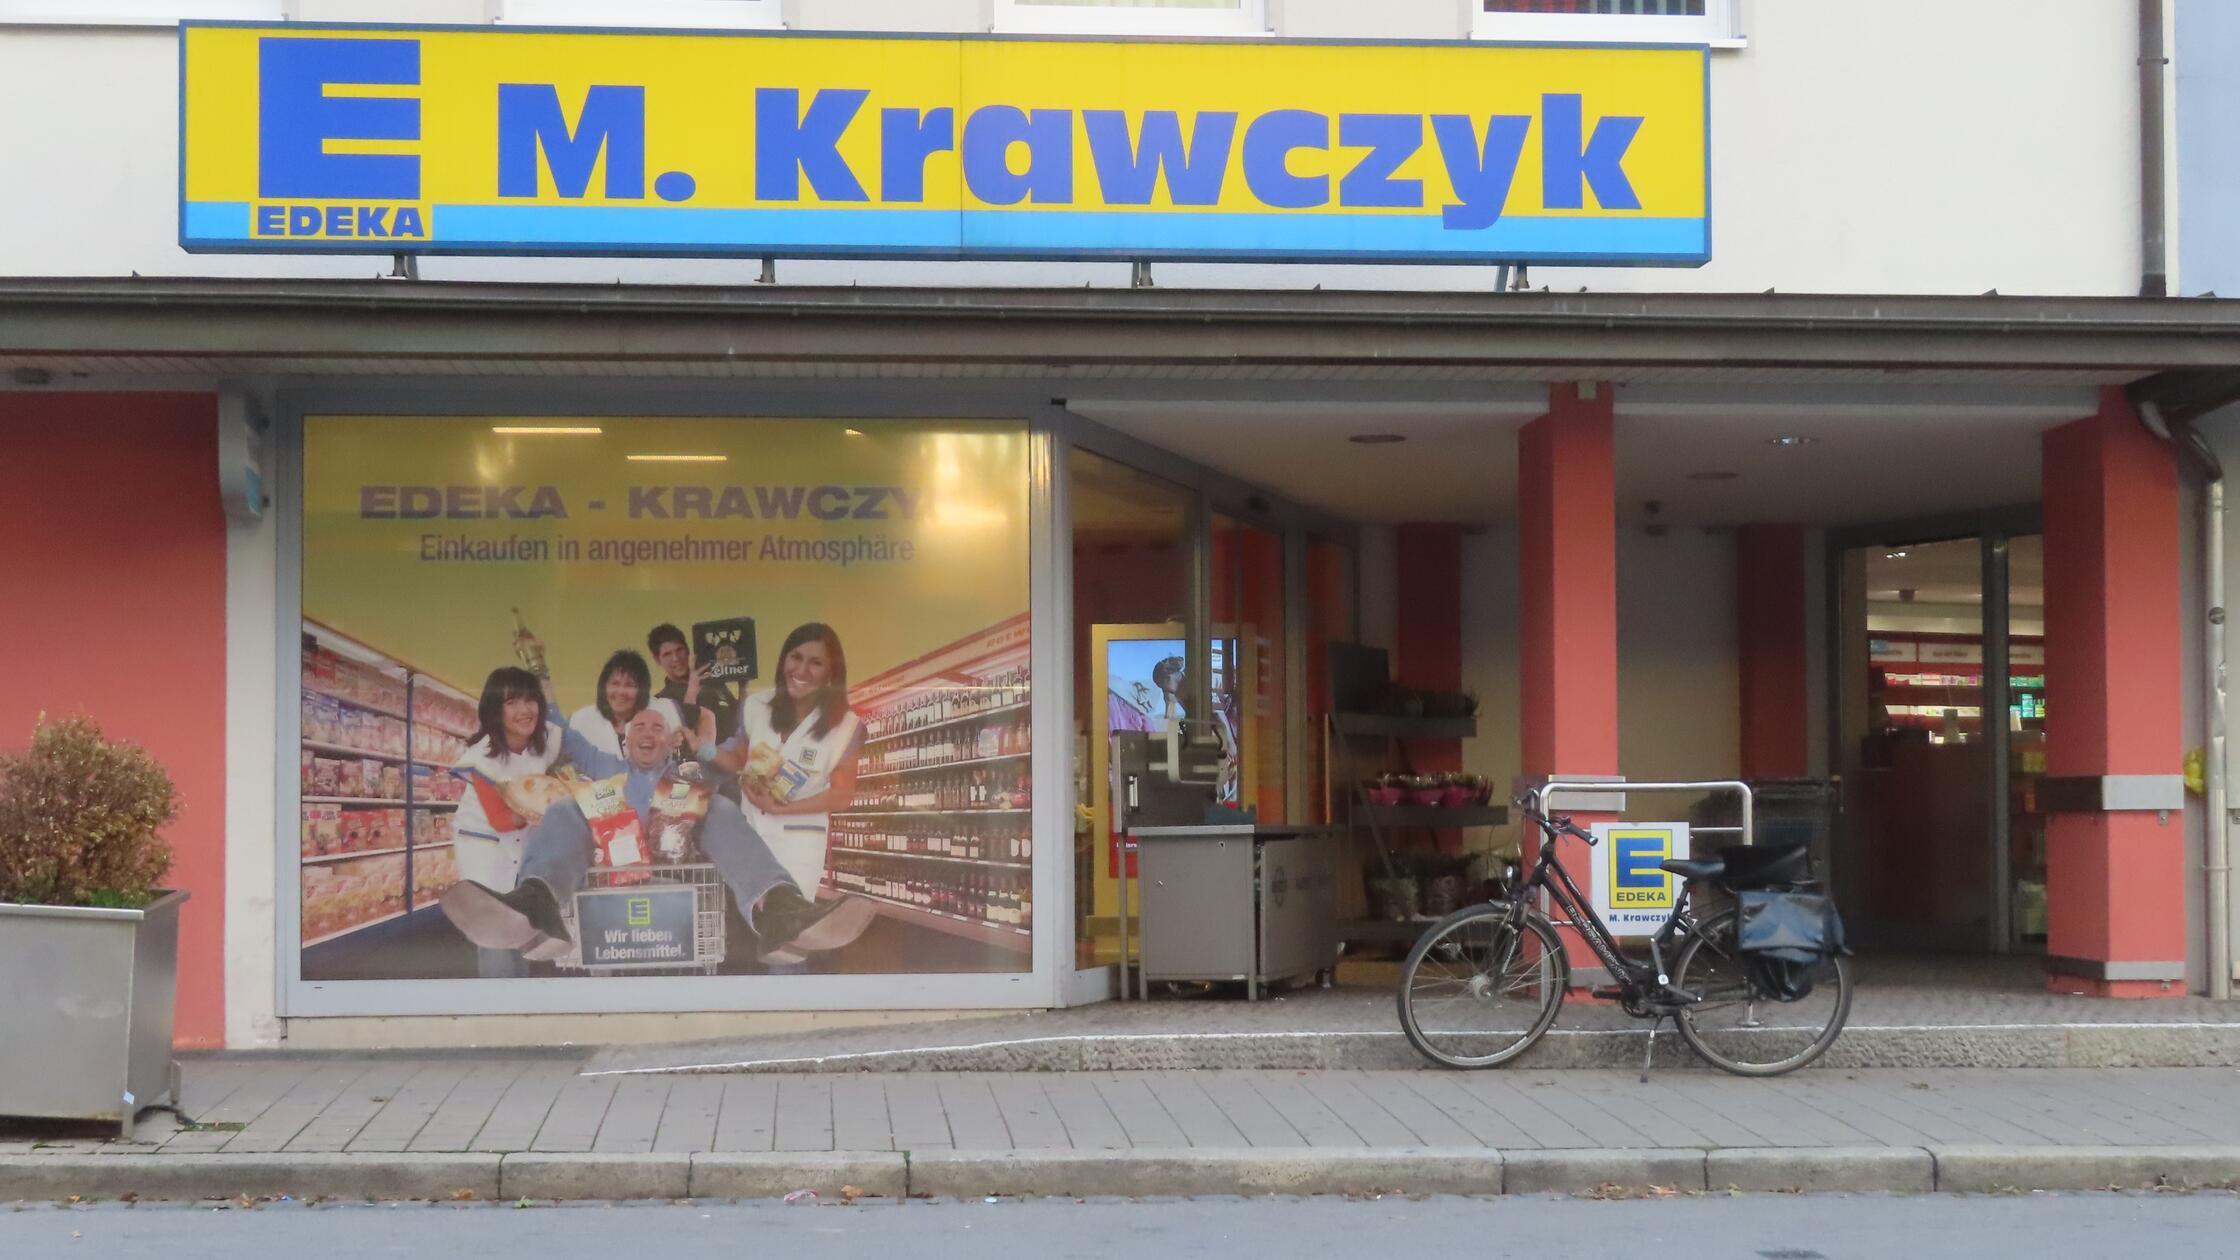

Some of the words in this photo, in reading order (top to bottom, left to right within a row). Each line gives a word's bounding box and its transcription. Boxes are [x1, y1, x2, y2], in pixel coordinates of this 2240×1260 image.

[259, 37, 421, 200] E
[497, 83, 697, 202] M.
[755, 88, 1645, 230] Krawczyk
[257, 206, 425, 237] EDEKA
[360, 485, 568, 519] EDEKA
[628, 485, 926, 520] KRAWCZY
[420, 534, 548, 561] Einkaufen
[558, 534, 579, 561] in
[588, 534, 752, 566] angenehmer
[759, 534, 915, 565] Atmosphäre
[1616, 837, 1665, 888] E
[1616, 892, 1666, 902] EDEKA
[1609, 914, 1620, 922] M.
[595, 943, 686, 960] Lebensmittel.
[604, 929, 628, 944] Wir
[632, 928, 672, 943] lieben
